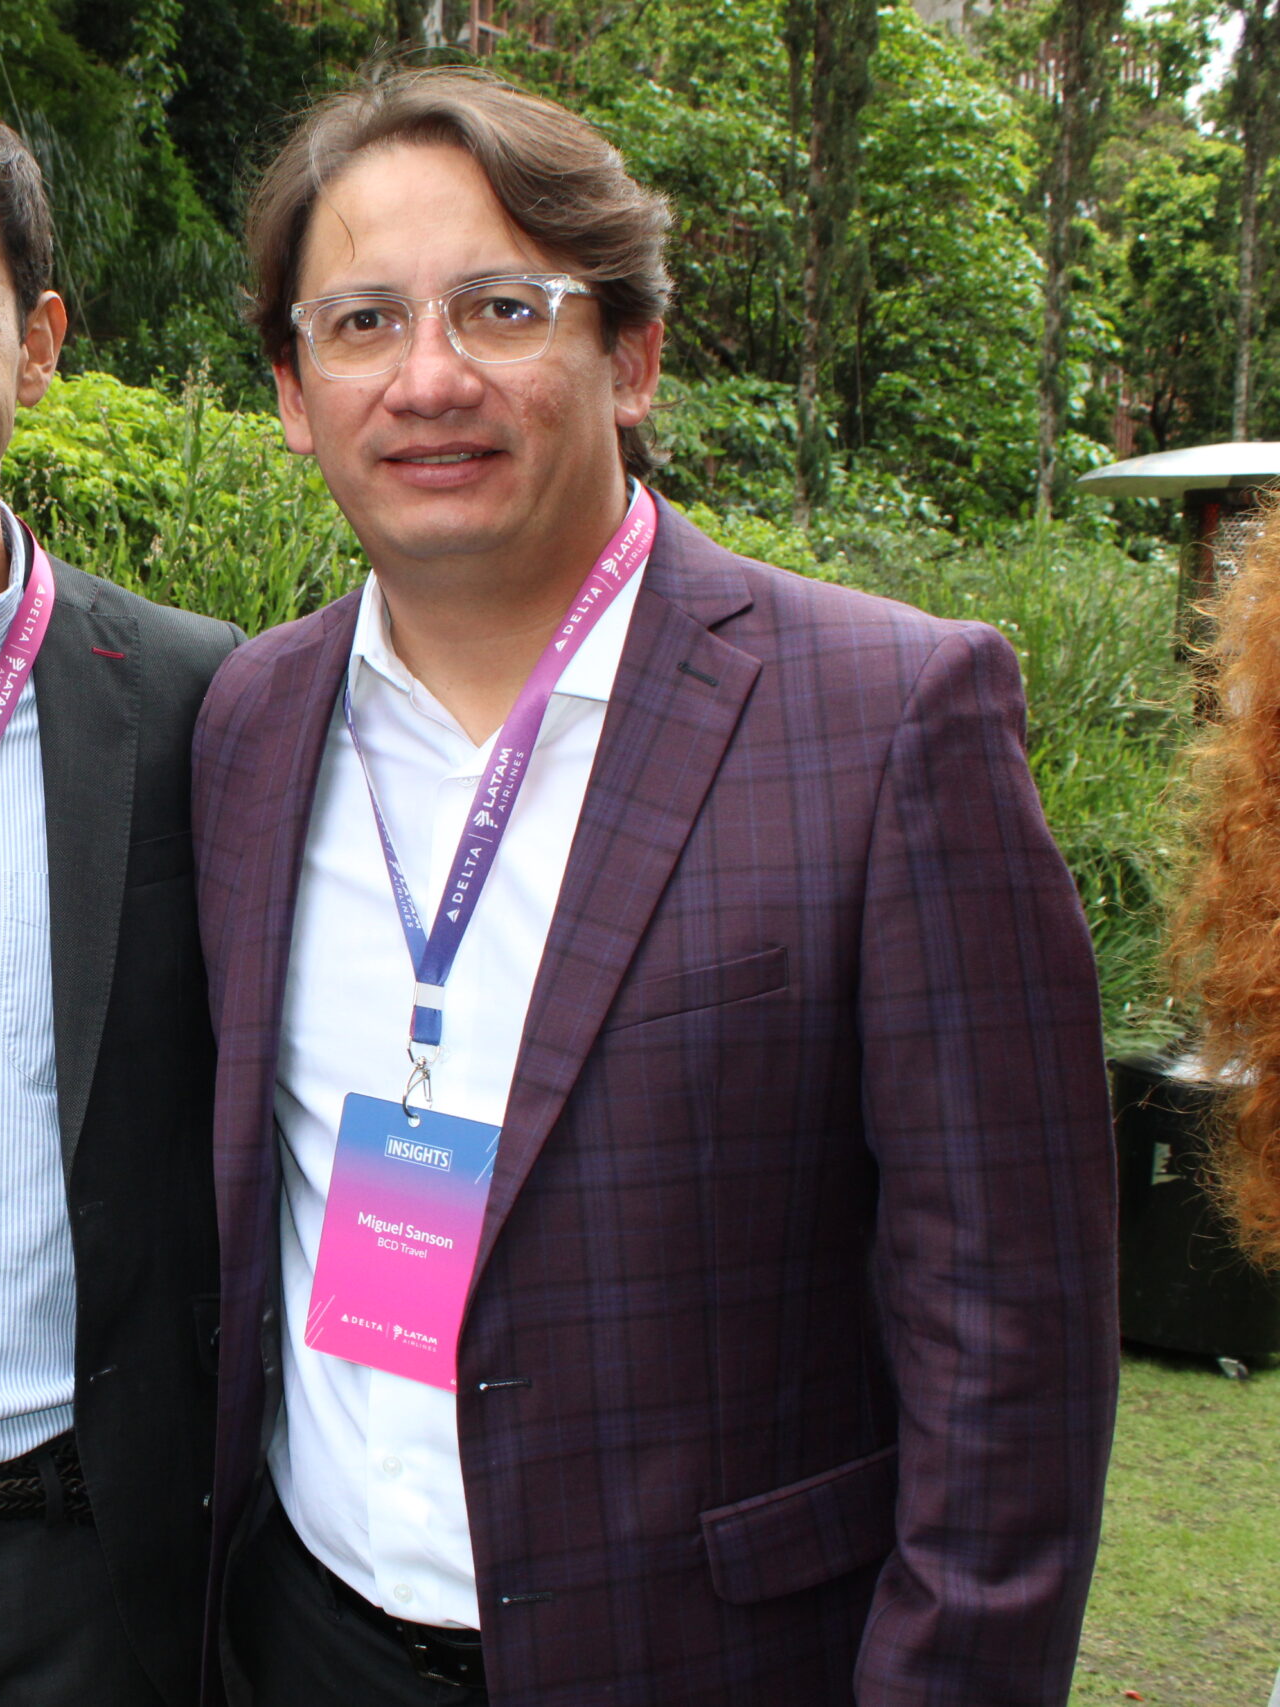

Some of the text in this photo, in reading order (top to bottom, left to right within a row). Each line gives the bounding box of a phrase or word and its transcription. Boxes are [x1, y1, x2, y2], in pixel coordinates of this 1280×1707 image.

[562, 518, 646, 635] DELTA LATAM
[19, 597, 43, 642] DELTA
[497, 751, 525, 813] AIRLINES
[451, 748, 513, 904] DELTA LATAM
[393, 874, 414, 928] AIRLINES
[388, 1139, 450, 1168] INSIGHTS
[357, 1211, 454, 1250] Miguel Sanson
[377, 1236, 428, 1259] BCD Travel
[351, 1315, 438, 1345] DELTA LATAM
[403, 1339, 437, 1353] AIRLINES
